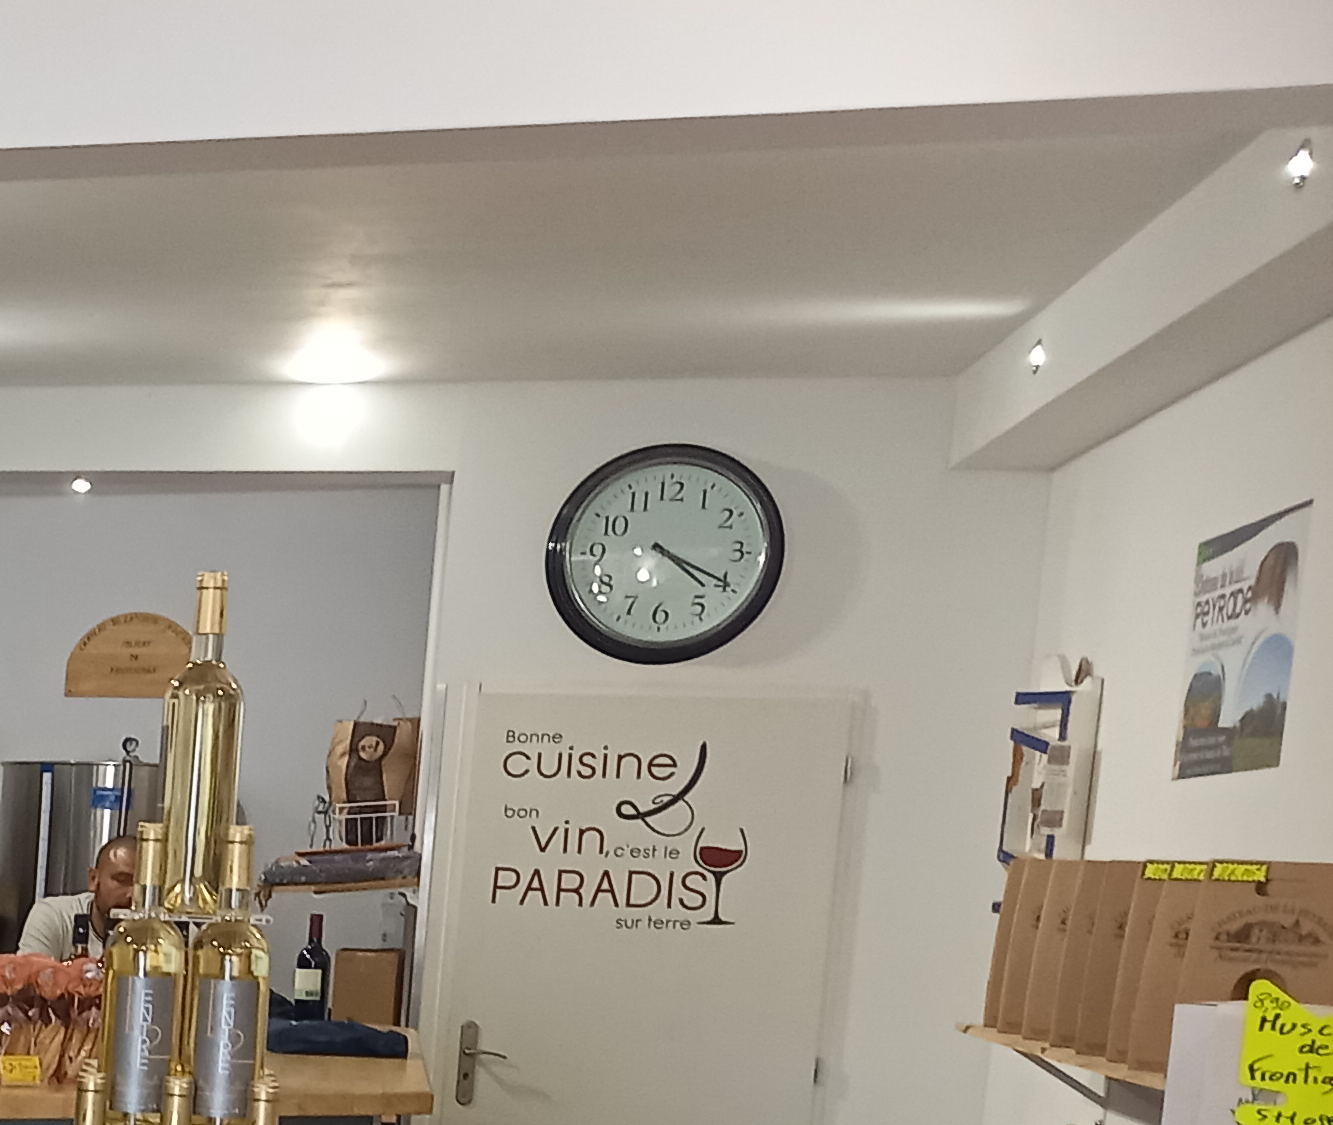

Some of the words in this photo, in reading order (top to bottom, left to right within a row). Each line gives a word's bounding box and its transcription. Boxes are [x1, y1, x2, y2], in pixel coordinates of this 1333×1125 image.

[630, 490, 649, 512] 11
[658, 480, 685, 504] 12
[700, 487, 710, 510] 1
[602, 515, 629, 537] 10
[717, 508, 735, 529] 2
[590, 543, 607, 564] 9
[731, 541, 745, 562] 3
[596, 574, 613, 593] 8
[713, 573, 731, 592] 4
[623, 595, 638, 616] 7
[651, 602, 670, 626] 6
[690, 596, 706, 617] 5
[505, 730, 563, 744] Bonne
[502, 747, 678, 780] cuisine
[504, 805, 540, 820] bon
[613, 843, 659, 860] c'est
[662, 844, 681, 860] le
[490, 866, 709, 911] PARADIS
[615, 917, 643, 930] sur
[646, 914, 692, 931] terre
